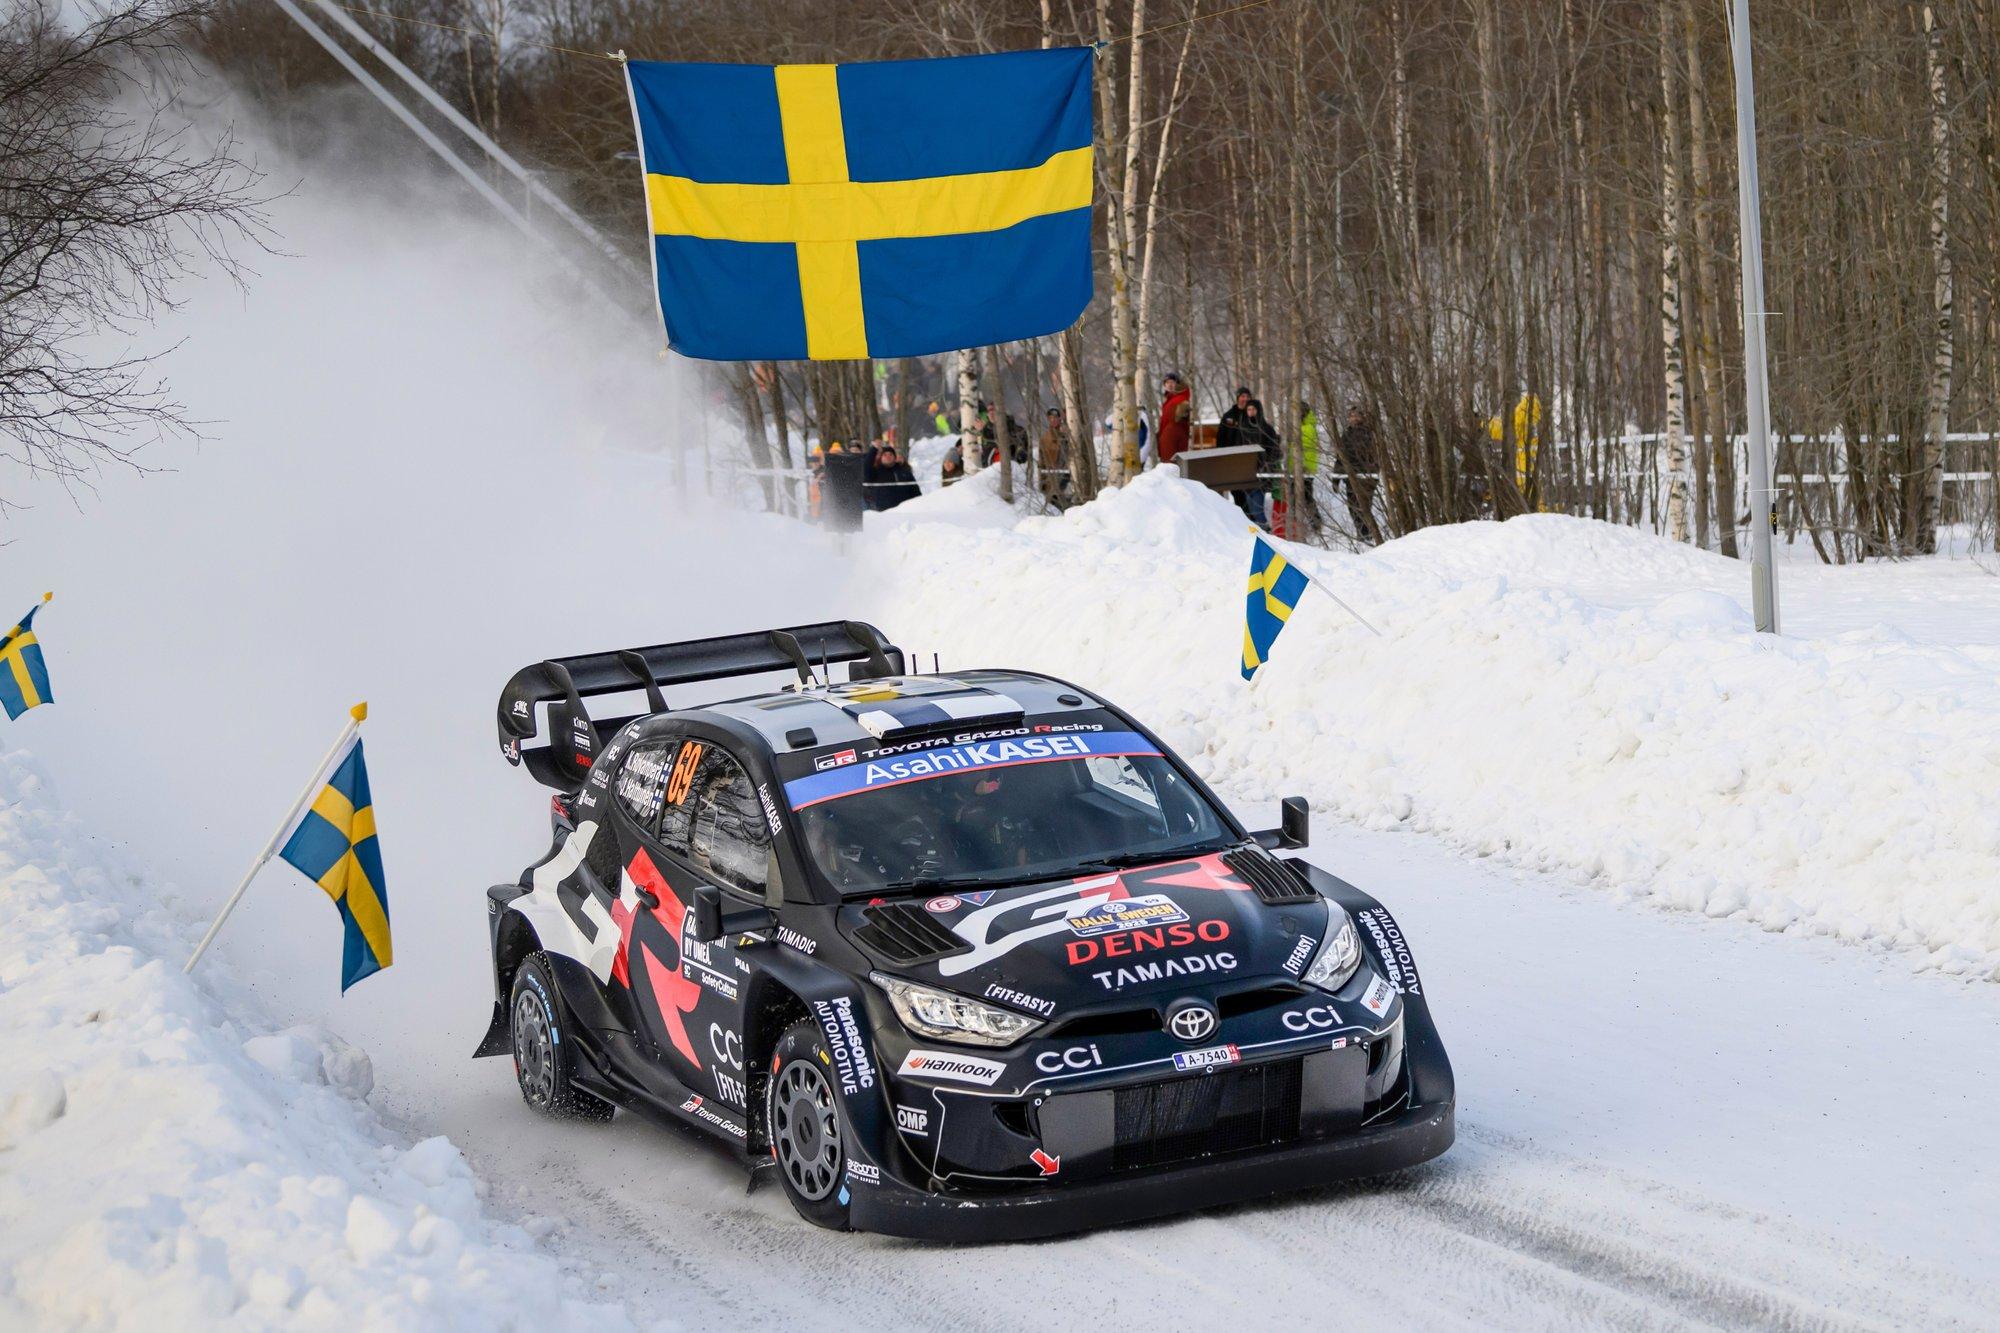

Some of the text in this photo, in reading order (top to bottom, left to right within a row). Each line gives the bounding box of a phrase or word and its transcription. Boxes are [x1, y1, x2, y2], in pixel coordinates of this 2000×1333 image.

[818, 723, 1104, 769] GR TOYOTA GAZOO Racing
[865, 735, 1091, 785] AsahiKASEI
[668, 741, 702, 806] 69
[1071, 914, 1112, 929] RALLY
[1118, 903, 1174, 921] SWEDEN
[777, 925, 817, 955] TAMADIC
[1065, 919, 1230, 966] DENSO
[1359, 911, 1406, 995] Panasonic
[1371, 907, 1421, 995] AUTOMOTIVE
[701, 971, 738, 998] SafetyCulture
[1092, 952, 1238, 990] TAMADIC
[813, 1000, 858, 1097] AUTOMOTIVE
[832, 996, 876, 1089] Panasonic
[1189, 1050, 1228, 1066] A-7540
[695, 1106, 723, 1126] TOYOTA
[720, 1120, 747, 1137] GAZOO
[897, 1110, 928, 1131] OMP
